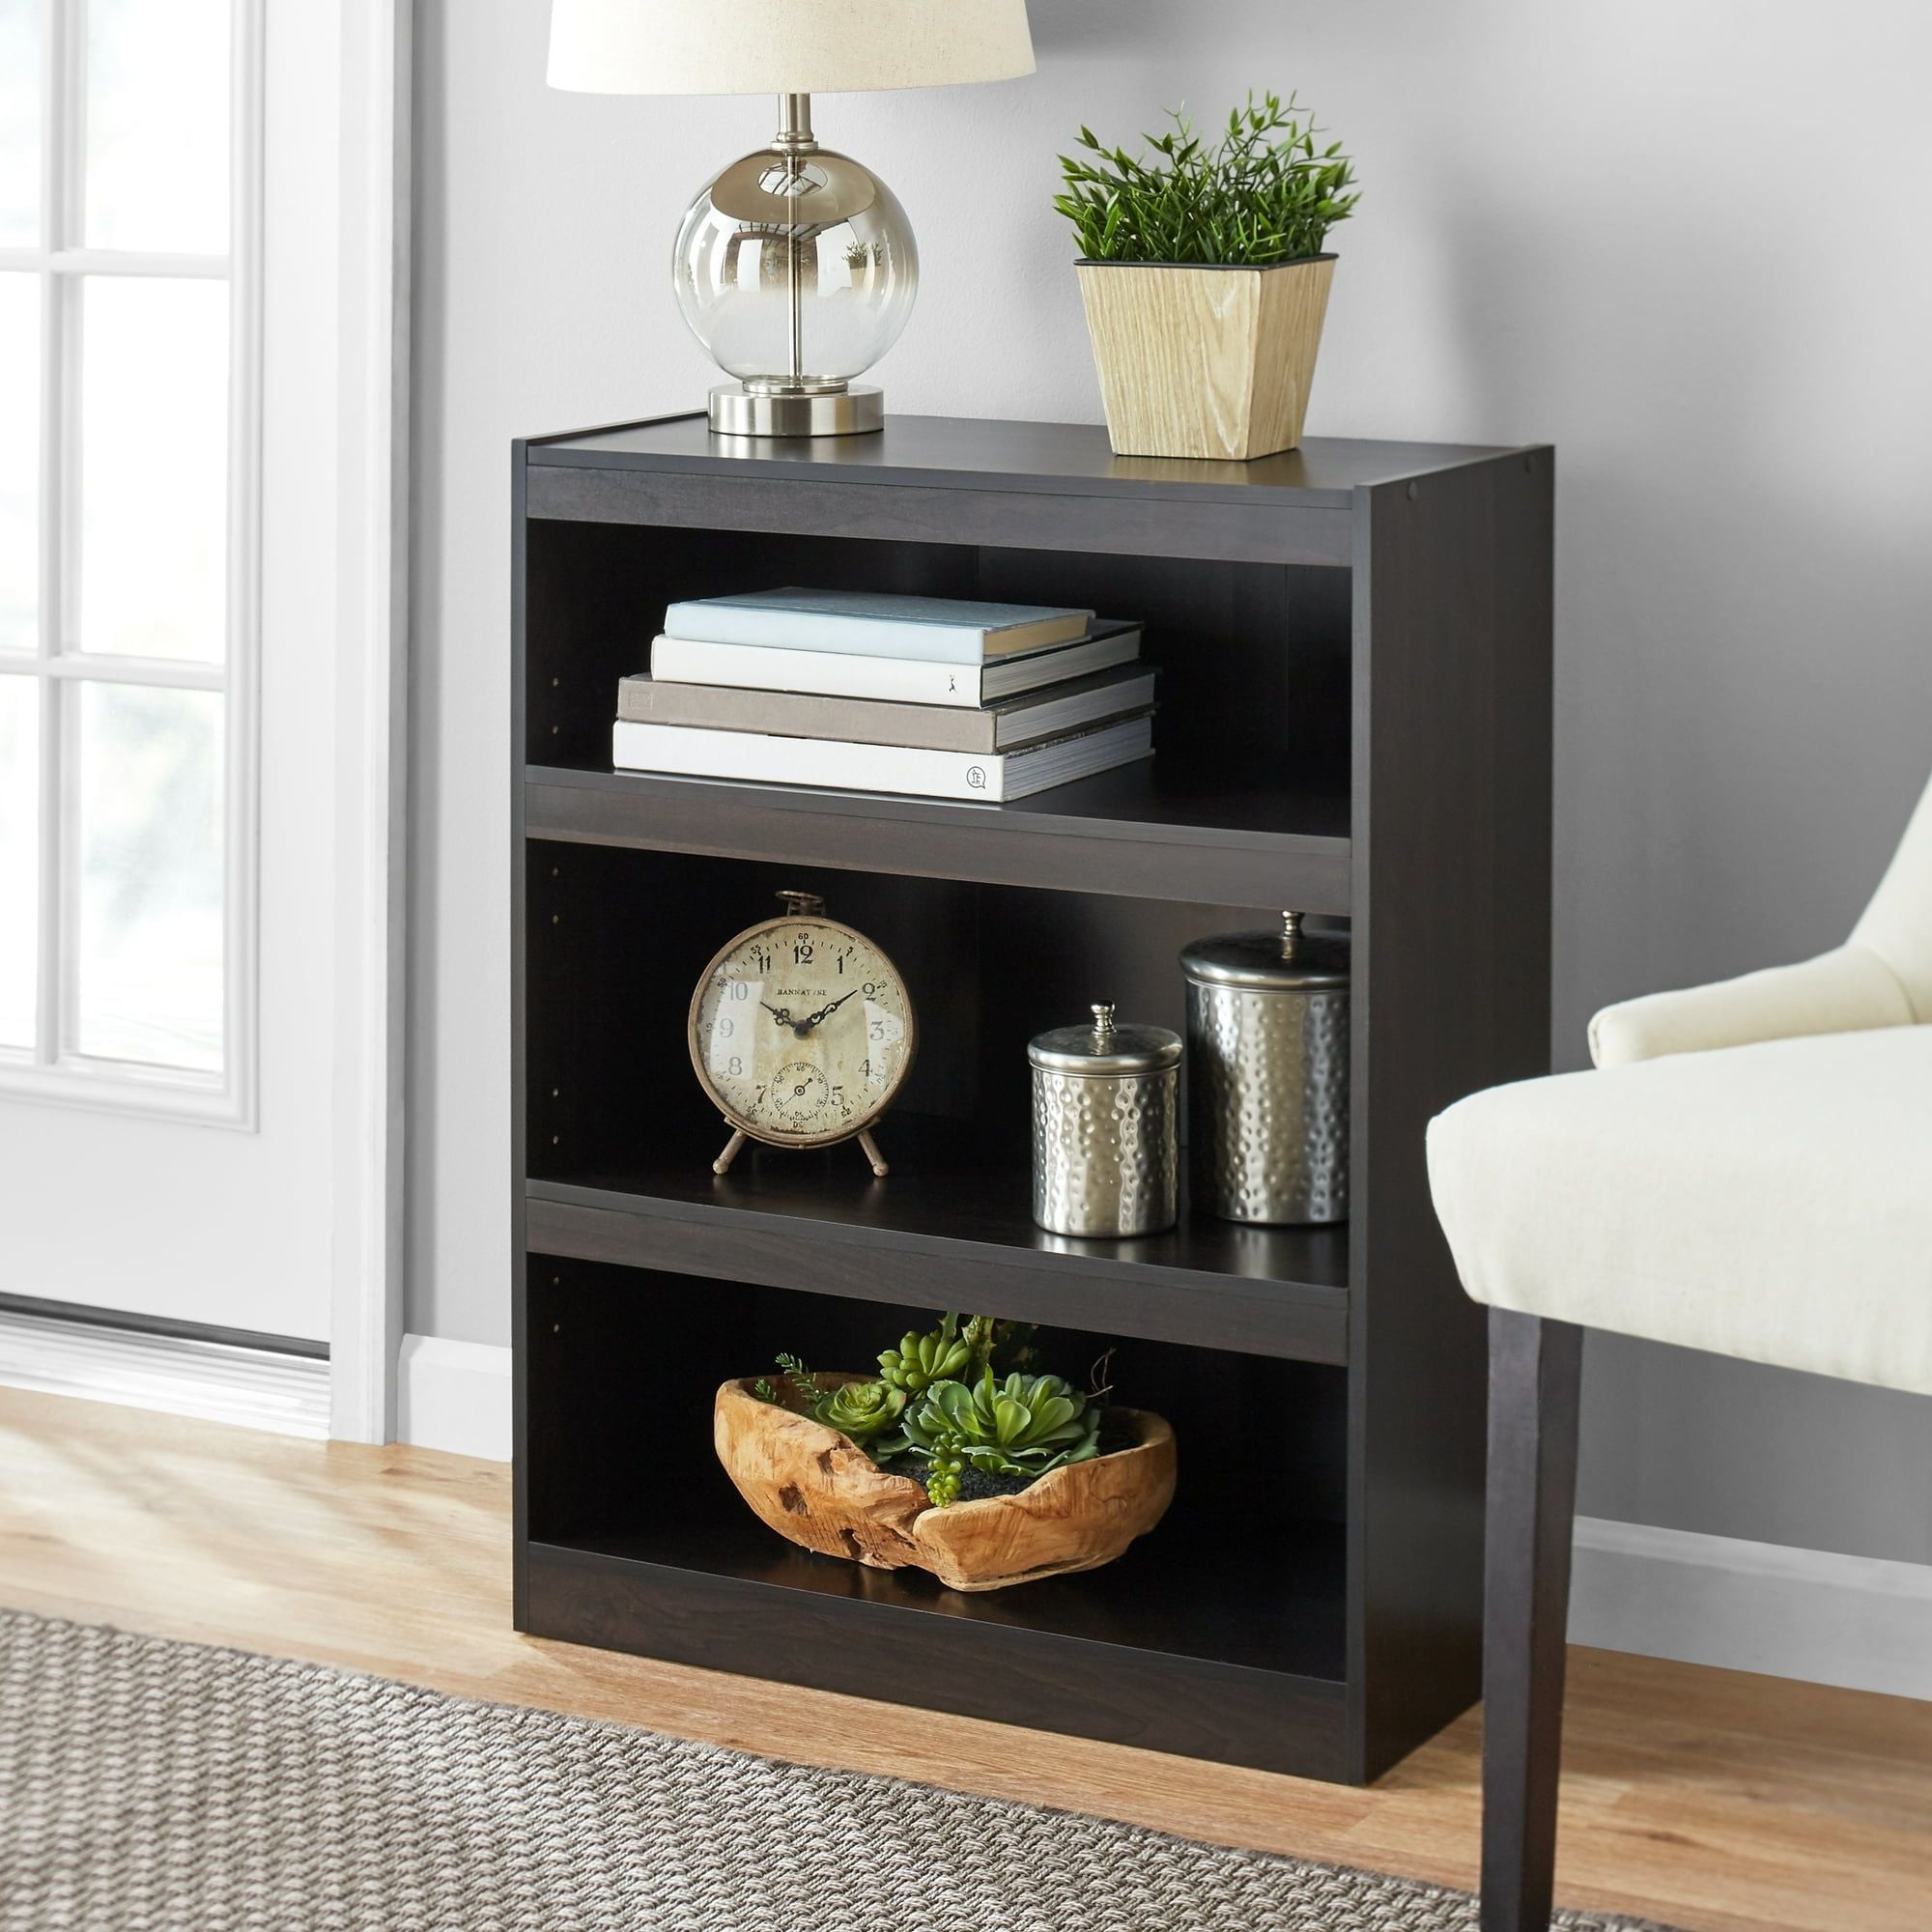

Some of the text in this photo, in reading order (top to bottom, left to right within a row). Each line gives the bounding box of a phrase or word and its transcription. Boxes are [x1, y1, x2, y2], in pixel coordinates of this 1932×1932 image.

[758, 955, 771, 974] 11
[793, 945, 812, 964] 12
[837, 955, 843, 974] 1
[728, 981, 749, 1001] 10
[862, 982, 876, 1002] 2
[720, 1018, 734, 1038] 9
[869, 1020, 885, 1041] 3
[728, 1056, 742, 1076] 8
[858, 1059, 873, 1077] 4
[755, 1084, 768, 1104] 7
[831, 1085, 844, 1106] 5
